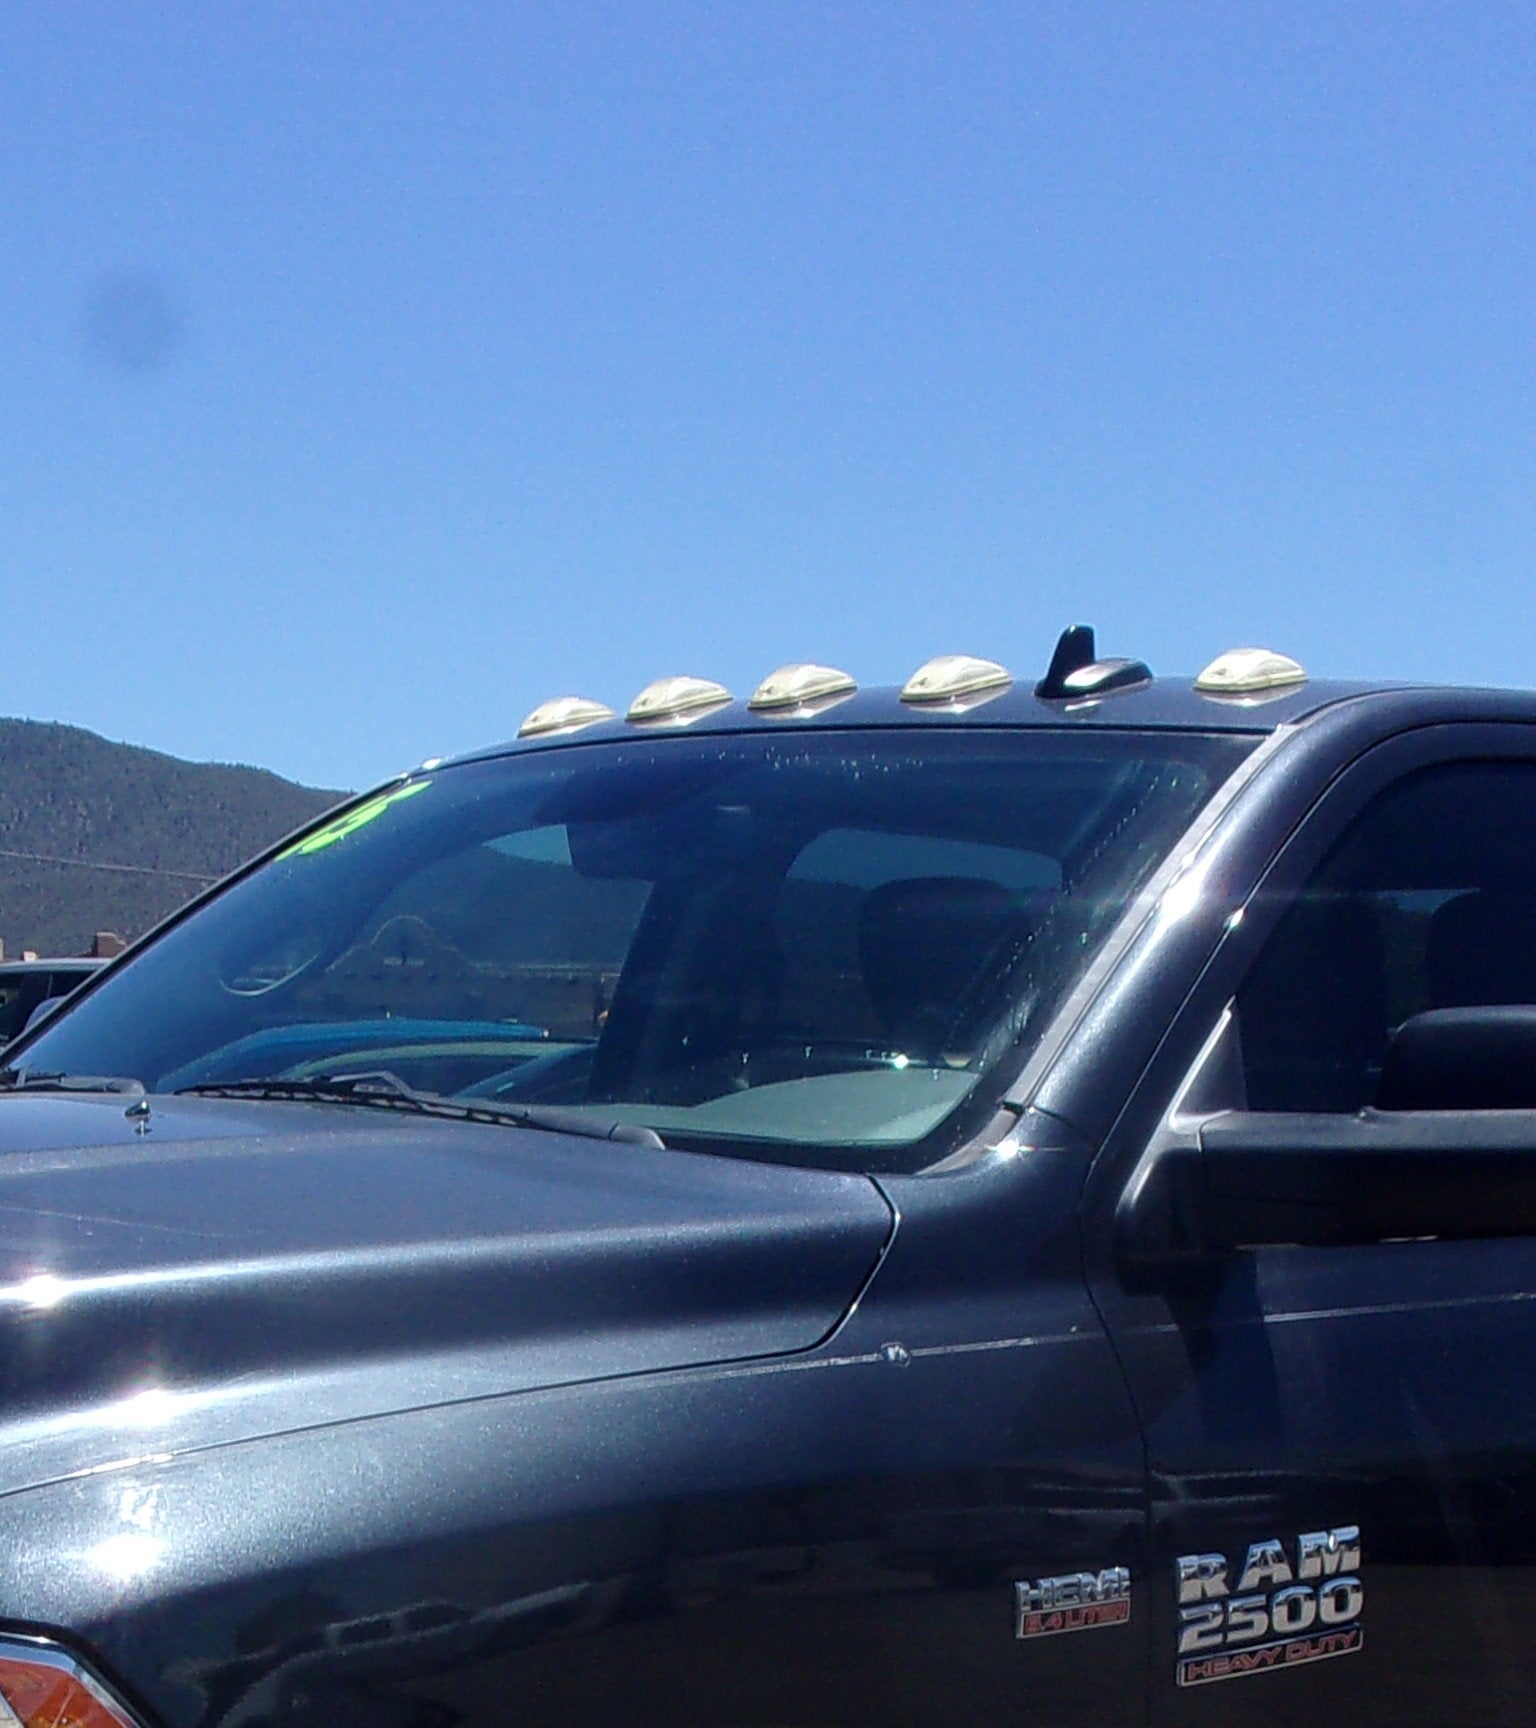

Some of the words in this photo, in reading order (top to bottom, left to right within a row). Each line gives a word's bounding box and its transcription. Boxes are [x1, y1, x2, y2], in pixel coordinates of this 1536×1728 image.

[1015, 1566, 1130, 1611] HEMI
[1177, 1525, 1361, 1603] RAM
[1065, 1600, 1128, 1626] LITER
[1178, 1576, 1364, 1654] 2500
[1187, 1646, 1284, 1680] HEAVY
[1285, 1629, 1359, 1662] DUTY
